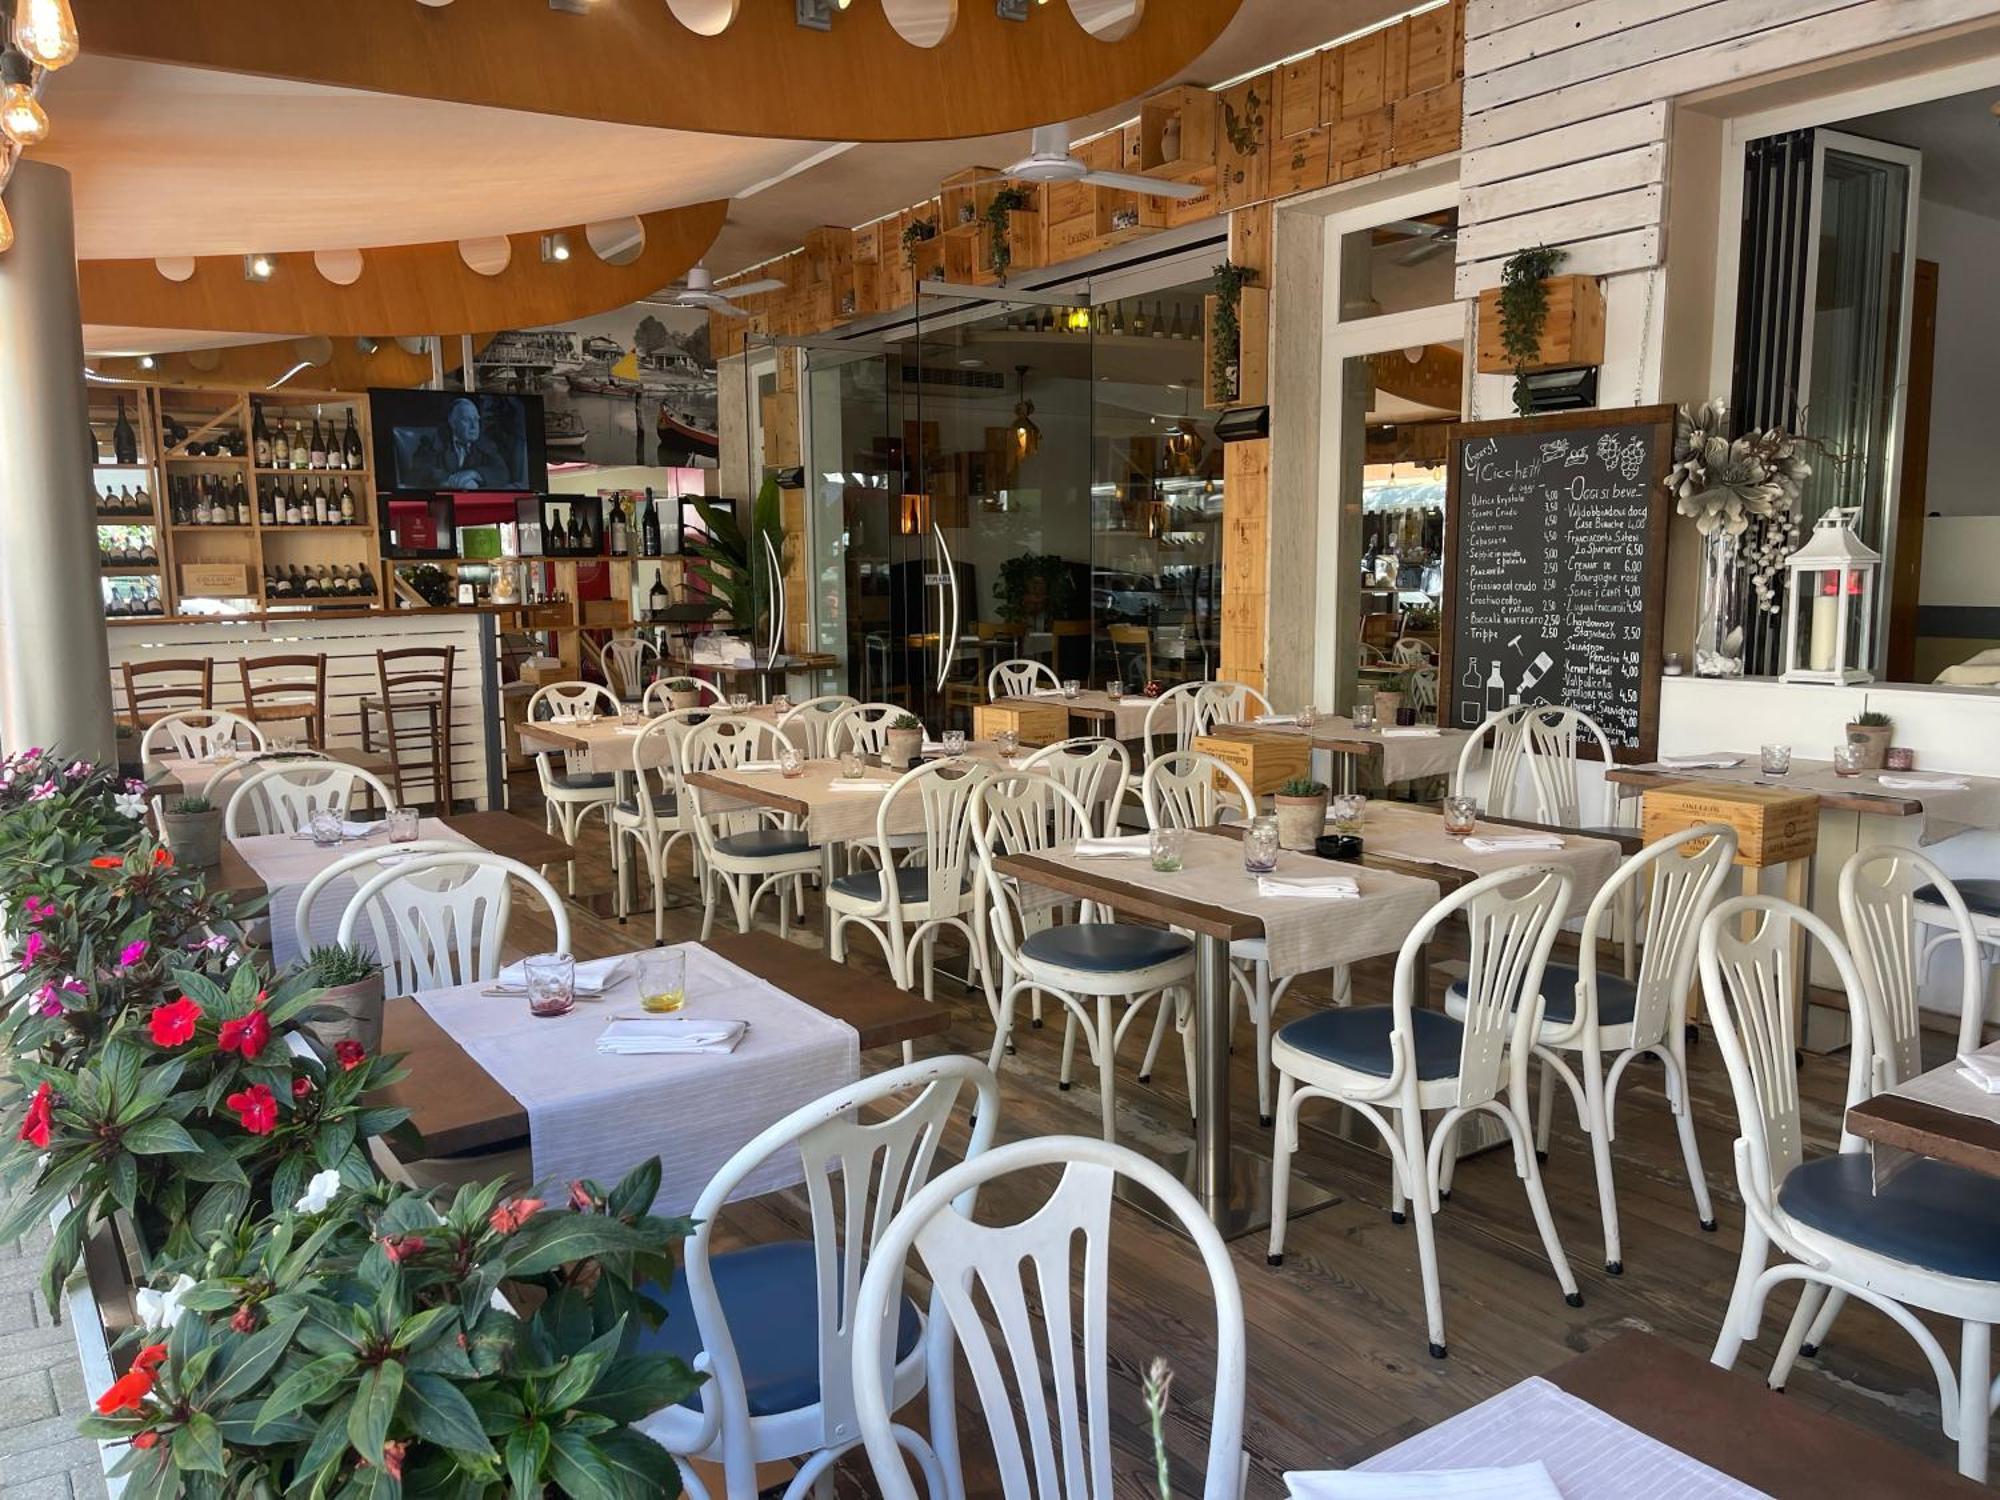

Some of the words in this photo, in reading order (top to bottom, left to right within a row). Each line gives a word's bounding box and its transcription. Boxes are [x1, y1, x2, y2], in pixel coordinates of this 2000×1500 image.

[1514, 581, 1537, 592] crudo
[1624, 584, 1641, 598] 4,00
[1566, 611, 1616, 631] Chardonnay
[1471, 627, 1498, 643] Trippe
[1622, 626, 1641, 640] 3,50
[1622, 650, 1640, 664] 4,00
